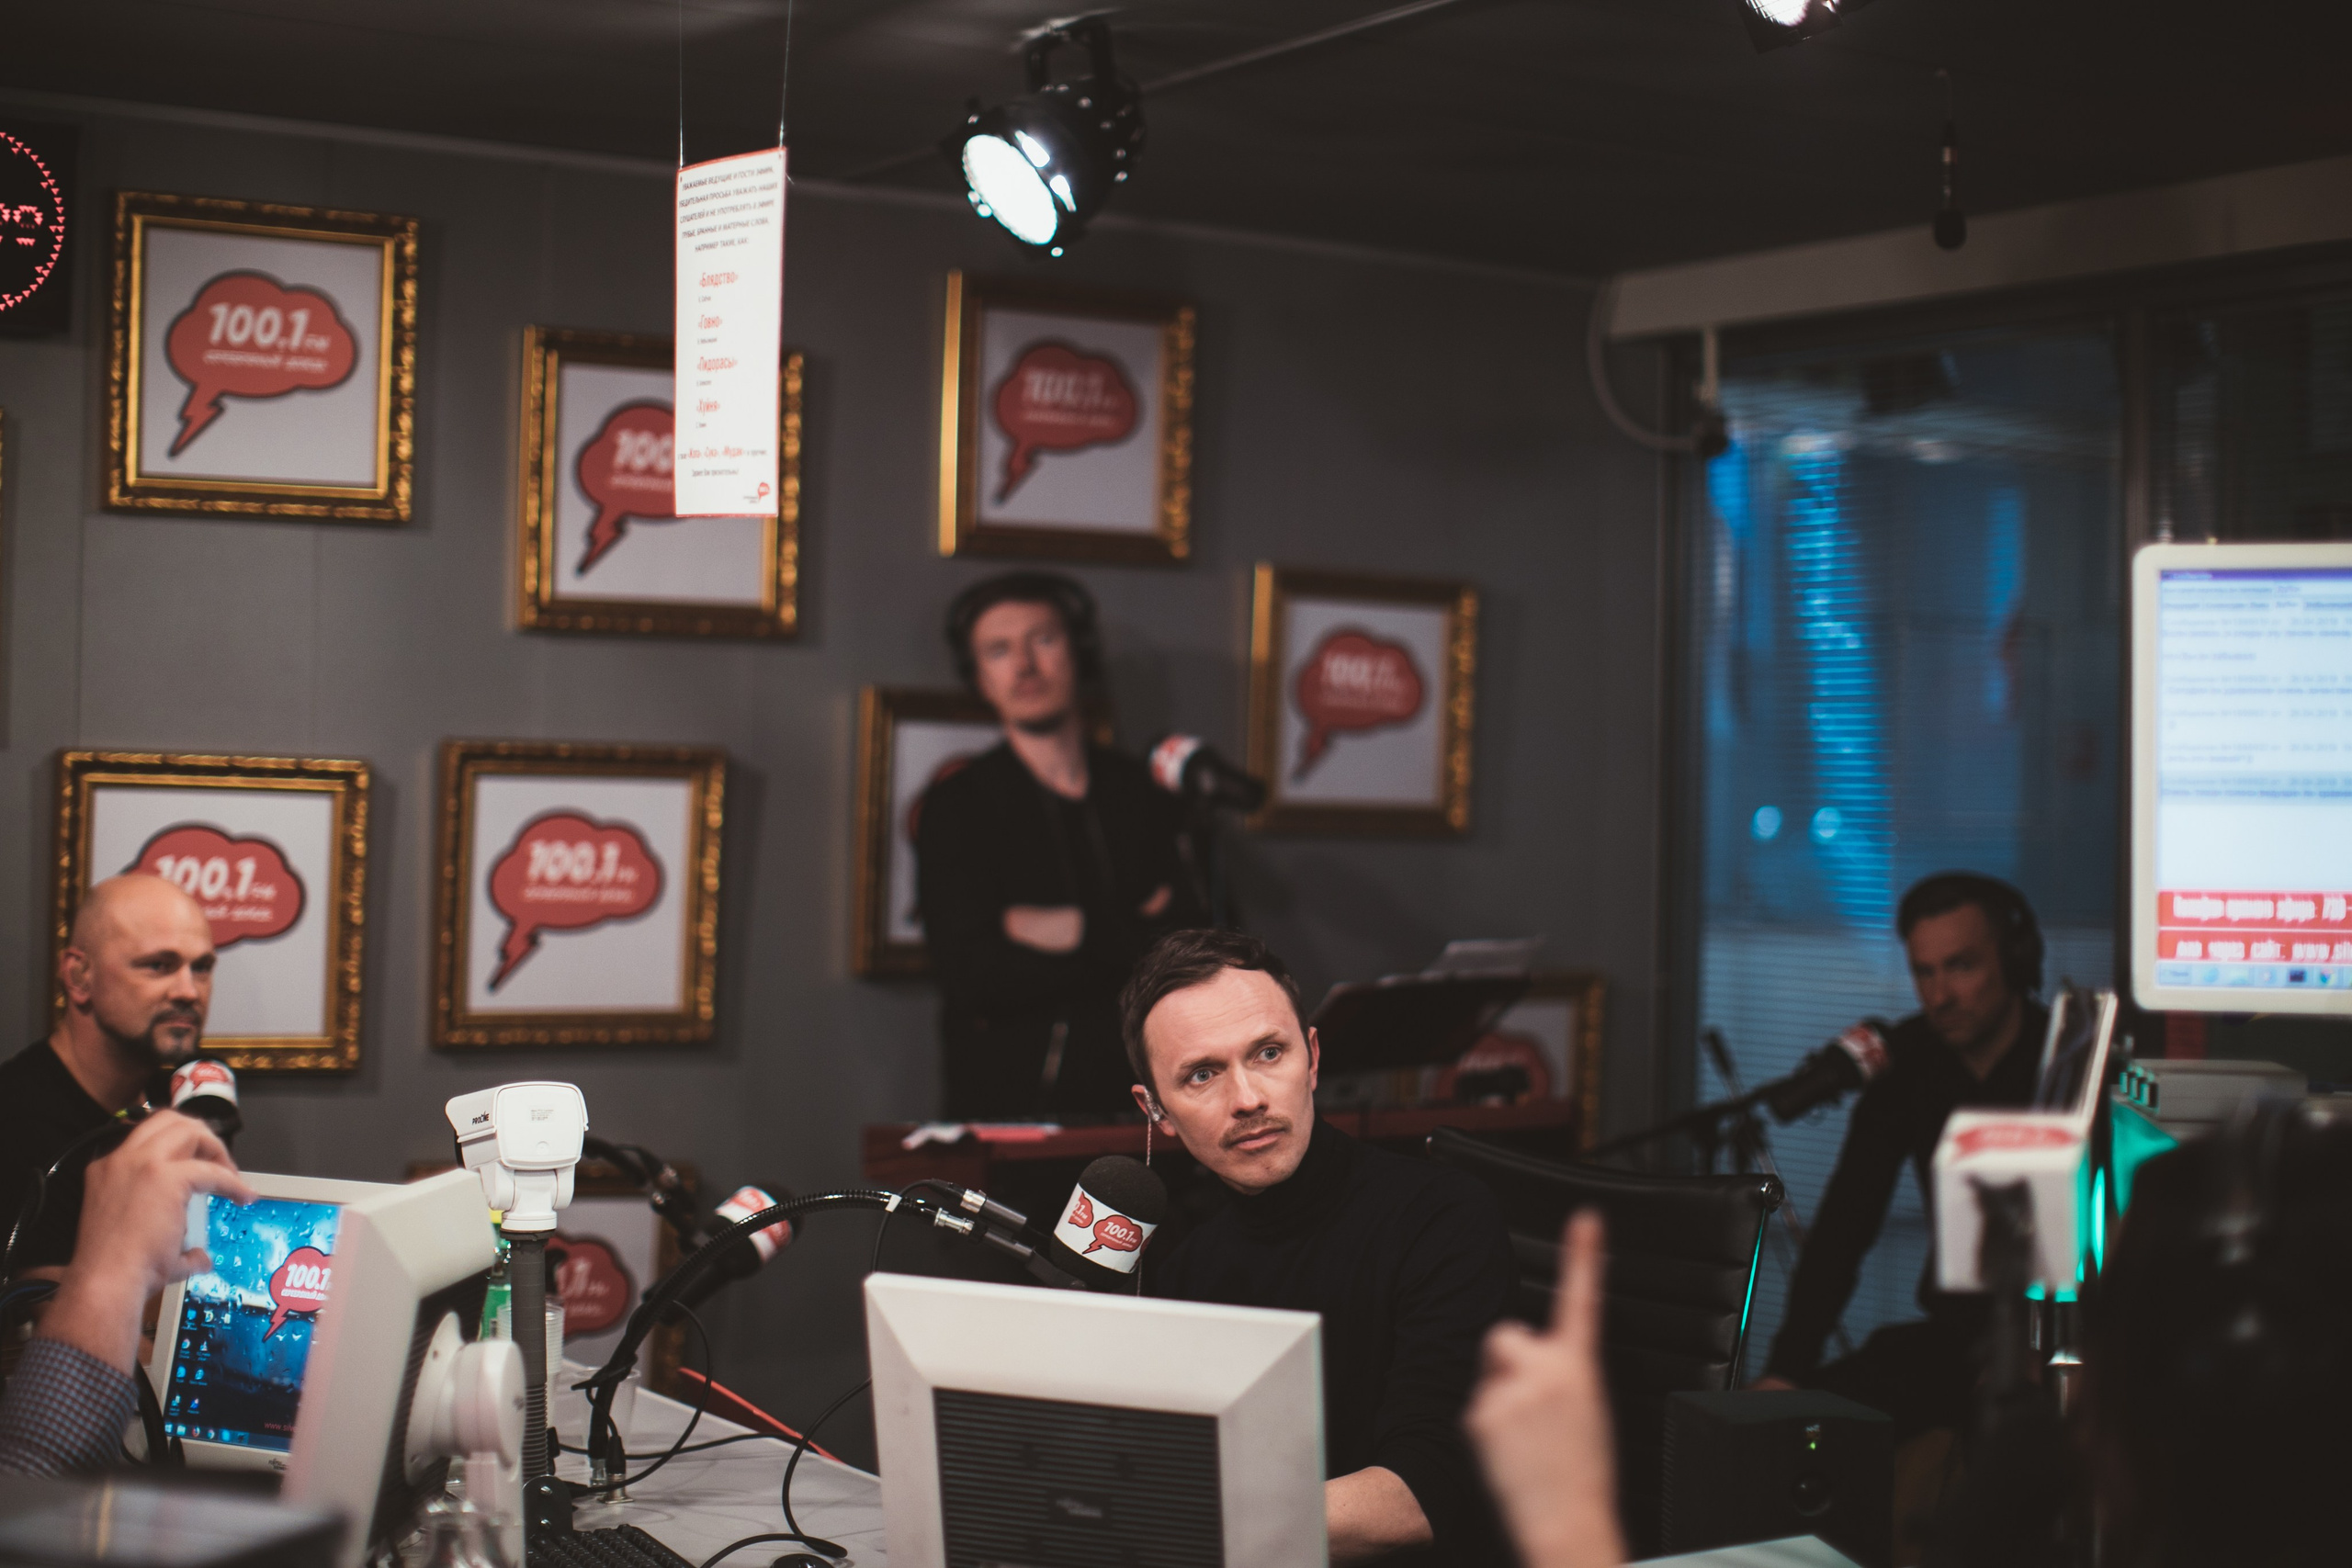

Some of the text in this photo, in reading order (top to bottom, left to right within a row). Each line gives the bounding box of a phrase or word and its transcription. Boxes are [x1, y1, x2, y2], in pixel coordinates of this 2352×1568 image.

[707, 174, 732, 185] ВЕДУЩИЕ
[709, 190, 731, 200] ПРОСЬБА
[732, 186, 757, 196] УВАЖАТЬ
[209, 302, 310, 351] 100.1
[528, 840, 621, 883] 100.1
[1103, 1222, 1135, 1242] 100.1
[285, 1263, 332, 1291] 100.1
